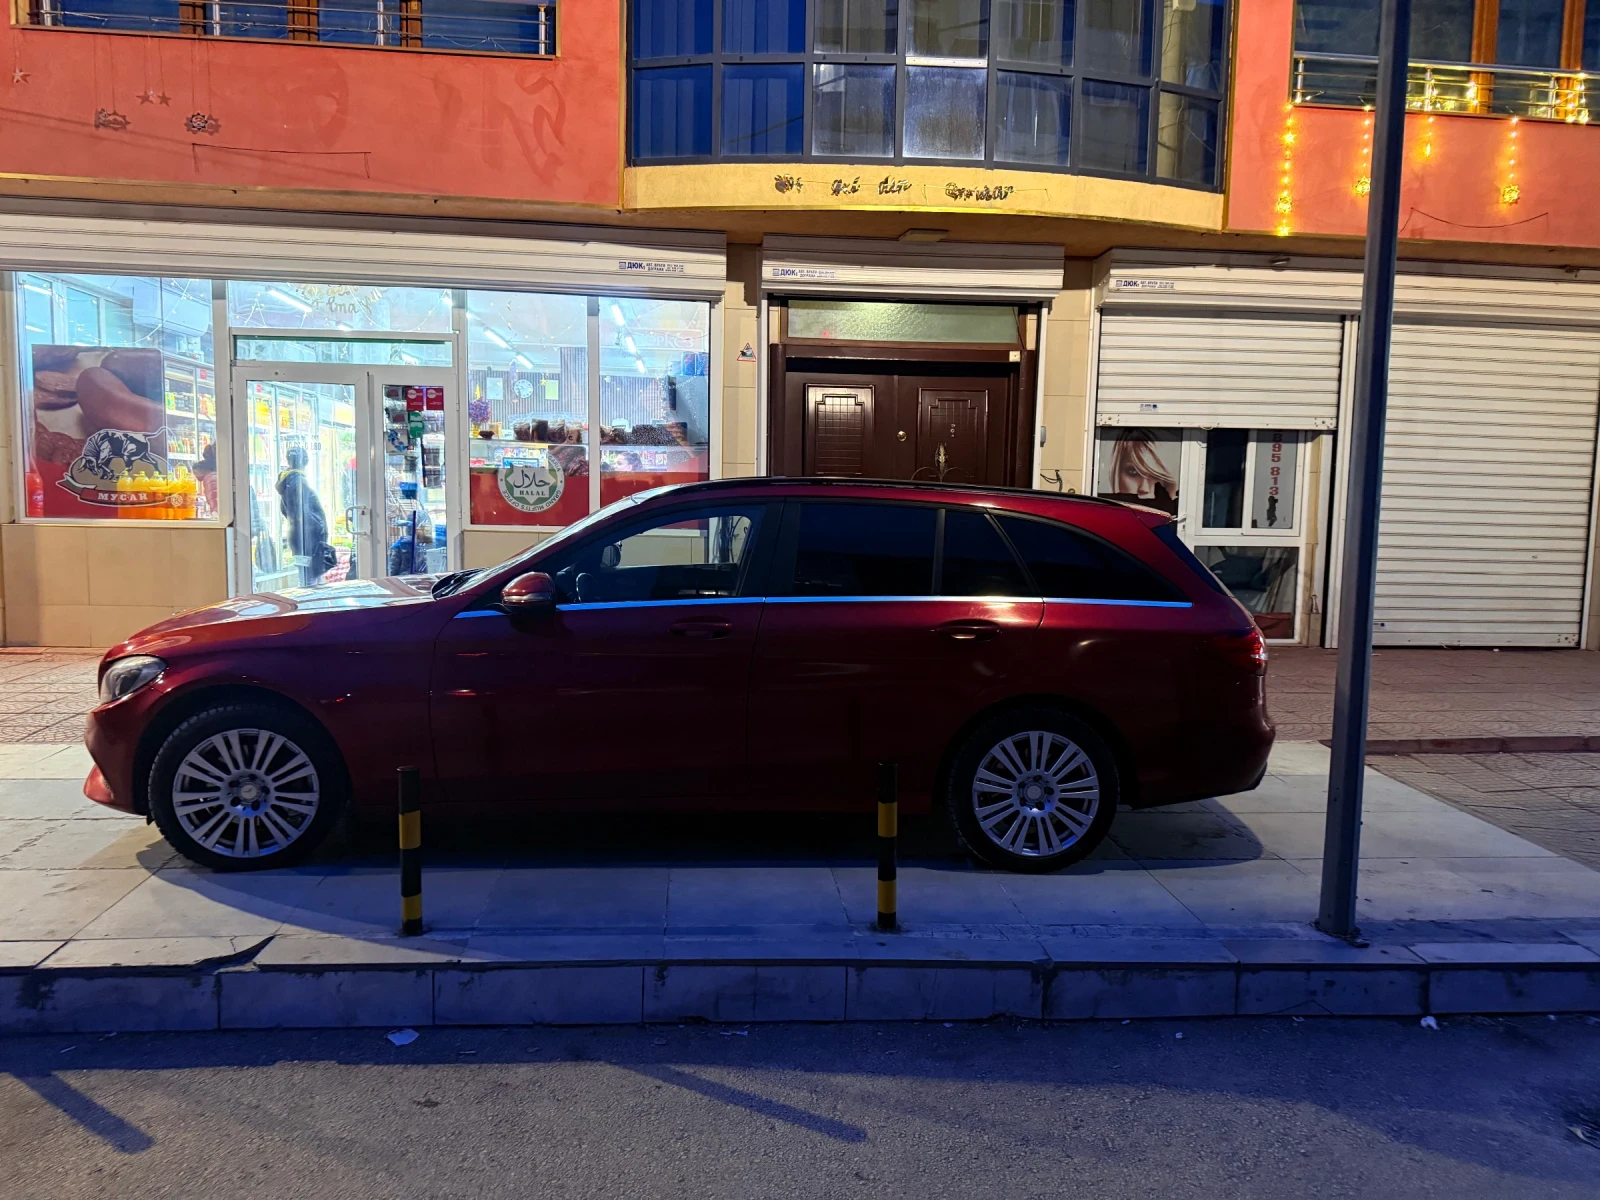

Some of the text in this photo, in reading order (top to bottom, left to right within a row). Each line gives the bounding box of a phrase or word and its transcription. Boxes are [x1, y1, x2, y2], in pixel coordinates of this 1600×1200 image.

[513, 469, 550, 489] حلال
[501, 490, 520, 508] OFFICE
[545, 490, 562, 508] GRAND
